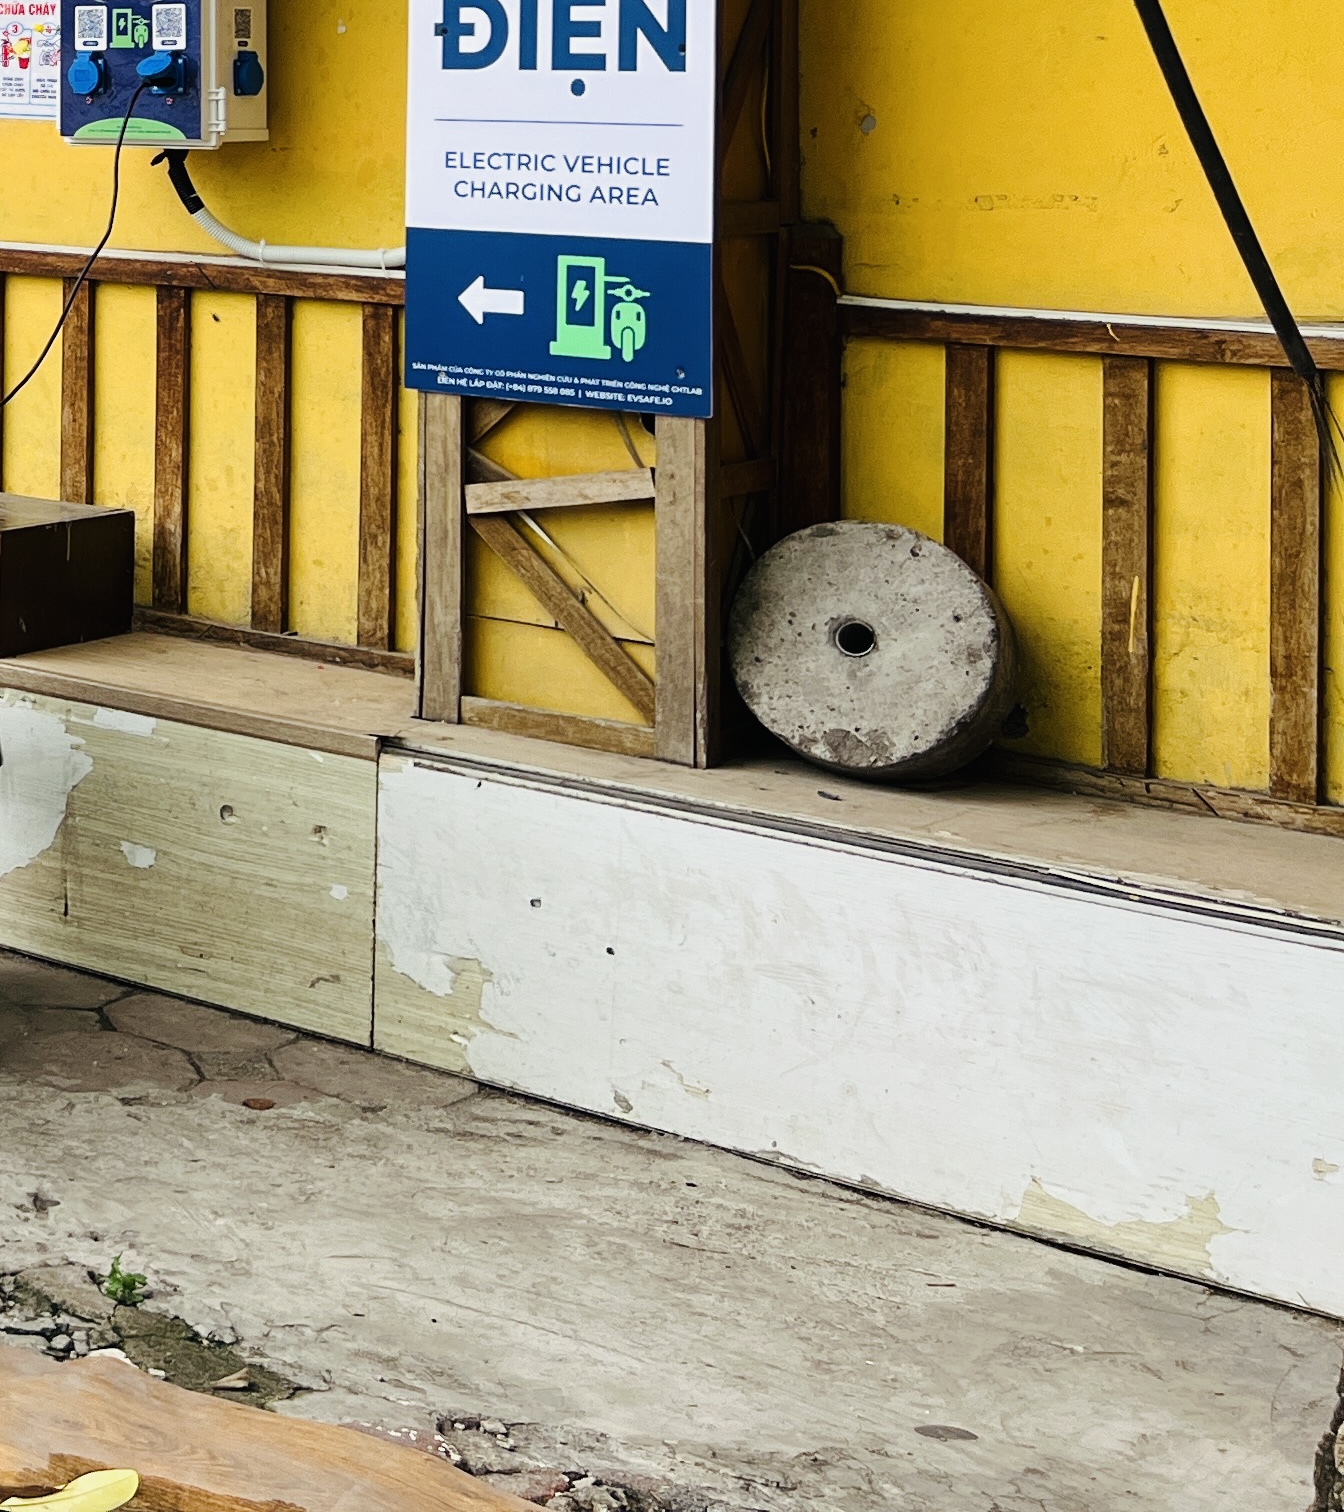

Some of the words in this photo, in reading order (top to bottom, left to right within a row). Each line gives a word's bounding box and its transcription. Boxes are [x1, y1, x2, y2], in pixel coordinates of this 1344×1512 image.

[28, 1, 57, 16] CHÁY
[12, 24, 19, 34] 3
[445, 151, 556, 172] ELECTRIC
[563, 154, 670, 176] VEHICLE
[454, 180, 581, 203] CHARGING
[589, 186, 659, 206] AREA
